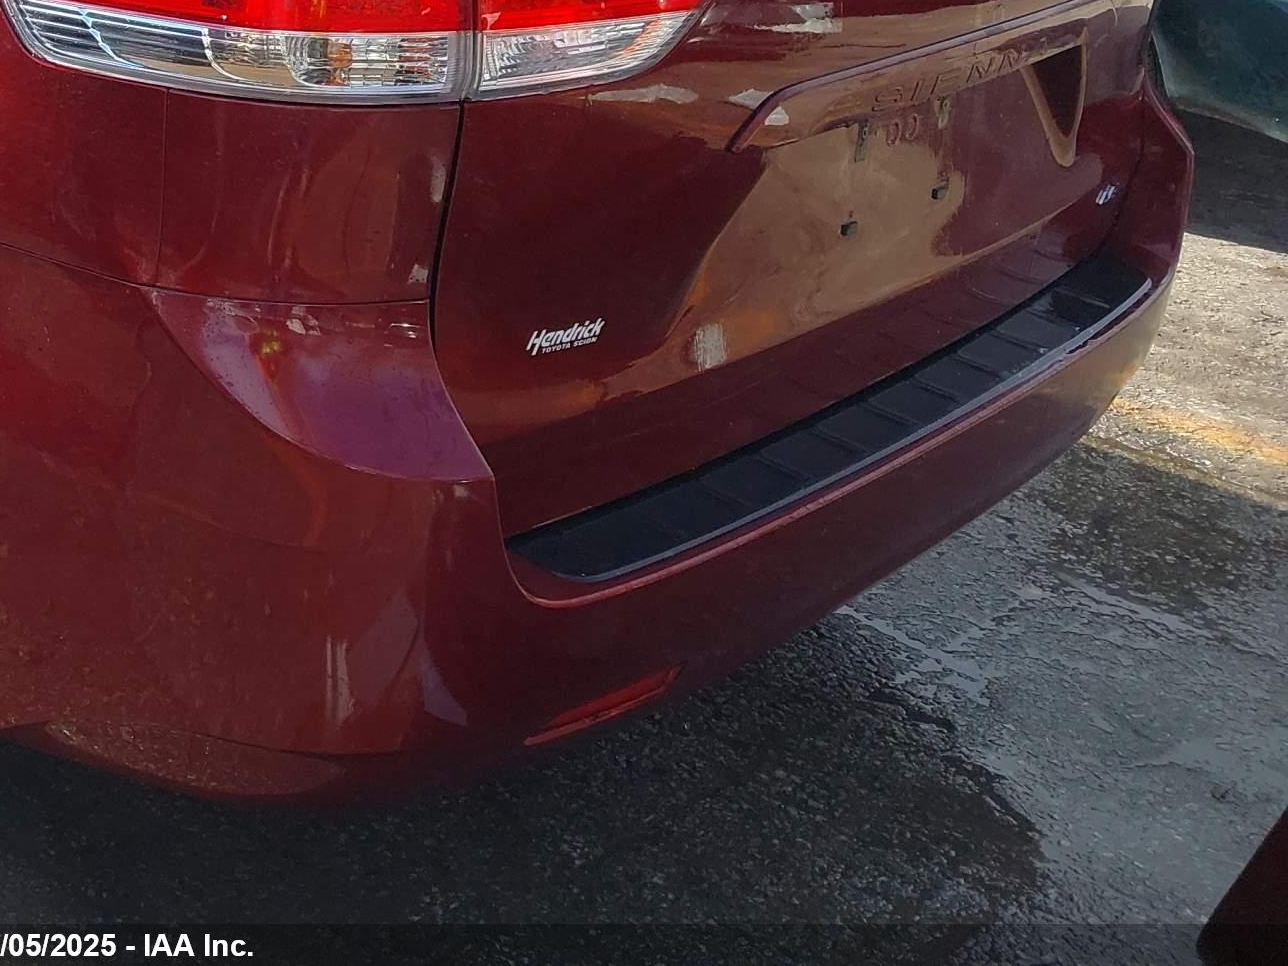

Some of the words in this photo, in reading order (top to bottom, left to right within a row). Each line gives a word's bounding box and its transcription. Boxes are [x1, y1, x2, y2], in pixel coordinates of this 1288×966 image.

[526, 317, 605, 356] Hendrick
[541, 342, 571, 354] TOYOTA
[573, 336, 598, 347] SCION
